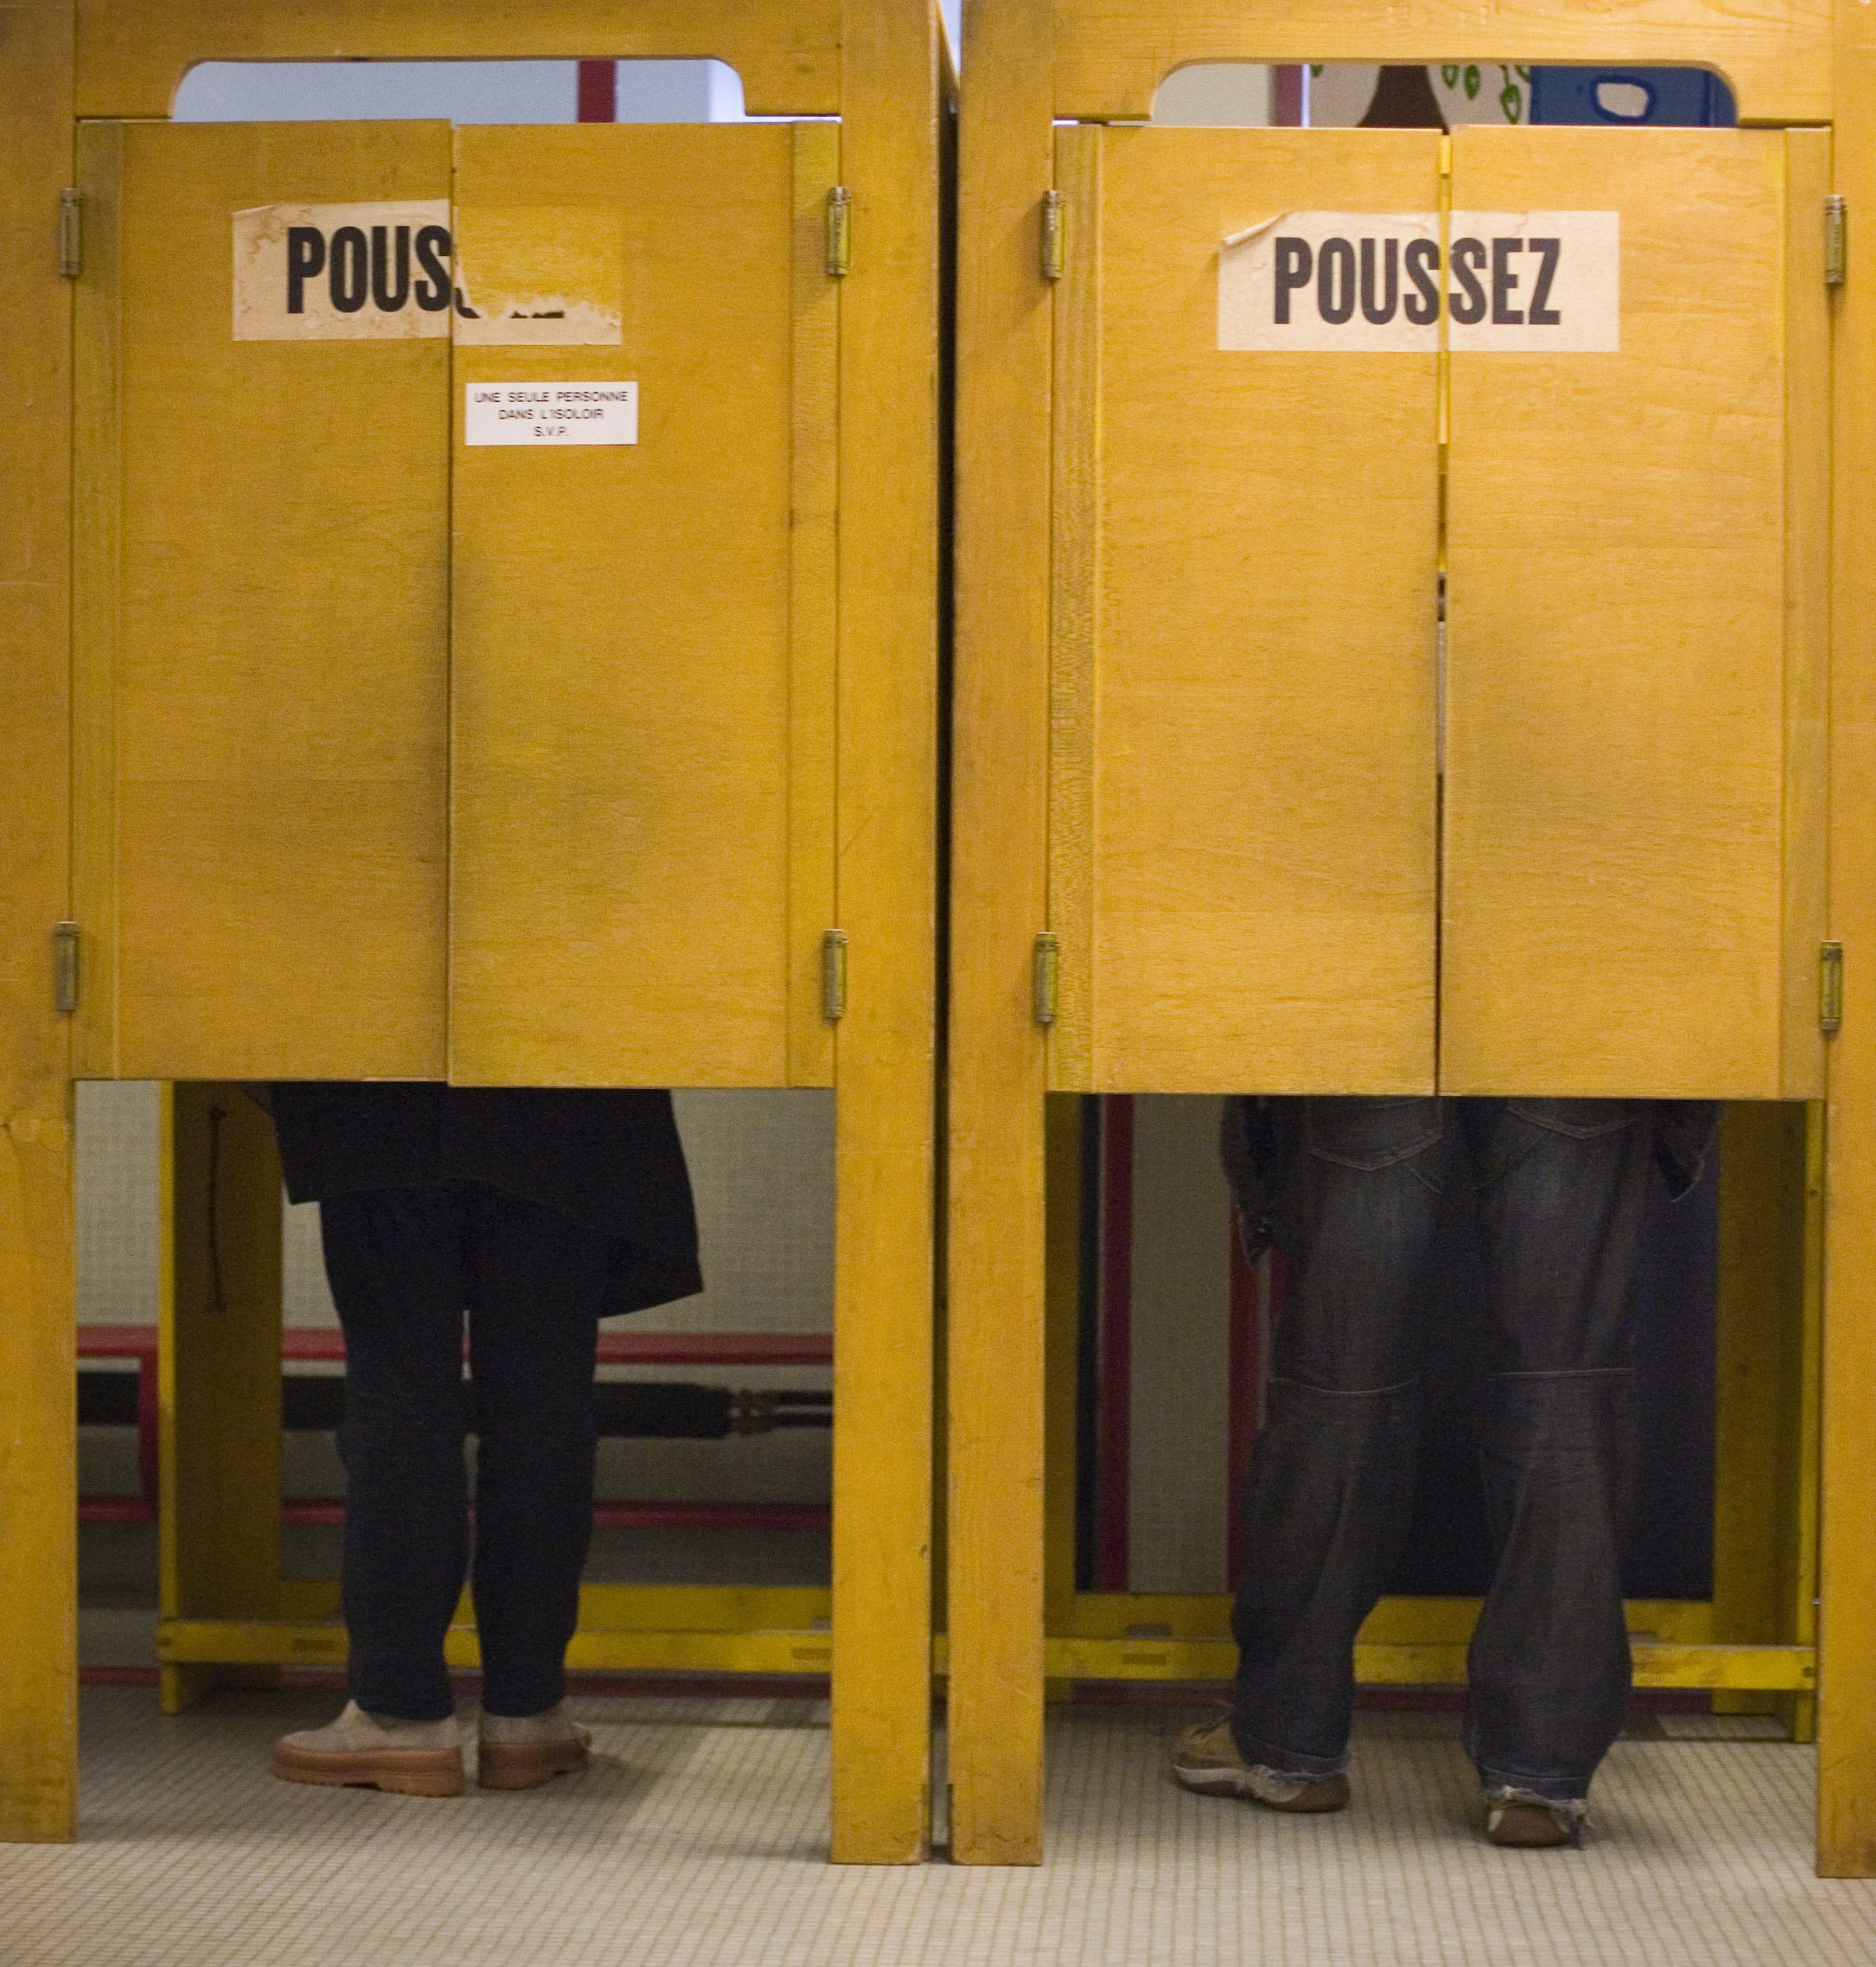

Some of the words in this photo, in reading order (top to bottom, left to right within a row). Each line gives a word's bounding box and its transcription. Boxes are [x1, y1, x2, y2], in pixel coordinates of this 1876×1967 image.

[286, 225, 565, 319] POUS
[1273, 237, 1562, 325] POUSSEZ
[474, 392, 500, 403] UNE
[507, 392, 549, 403] SEULE
[557, 391, 630, 402] PERSONNE
[498, 409, 534, 420] DANS
[541, 408, 605, 419] L'ISOLOIR
[534, 426, 570, 437] S.V.P.
